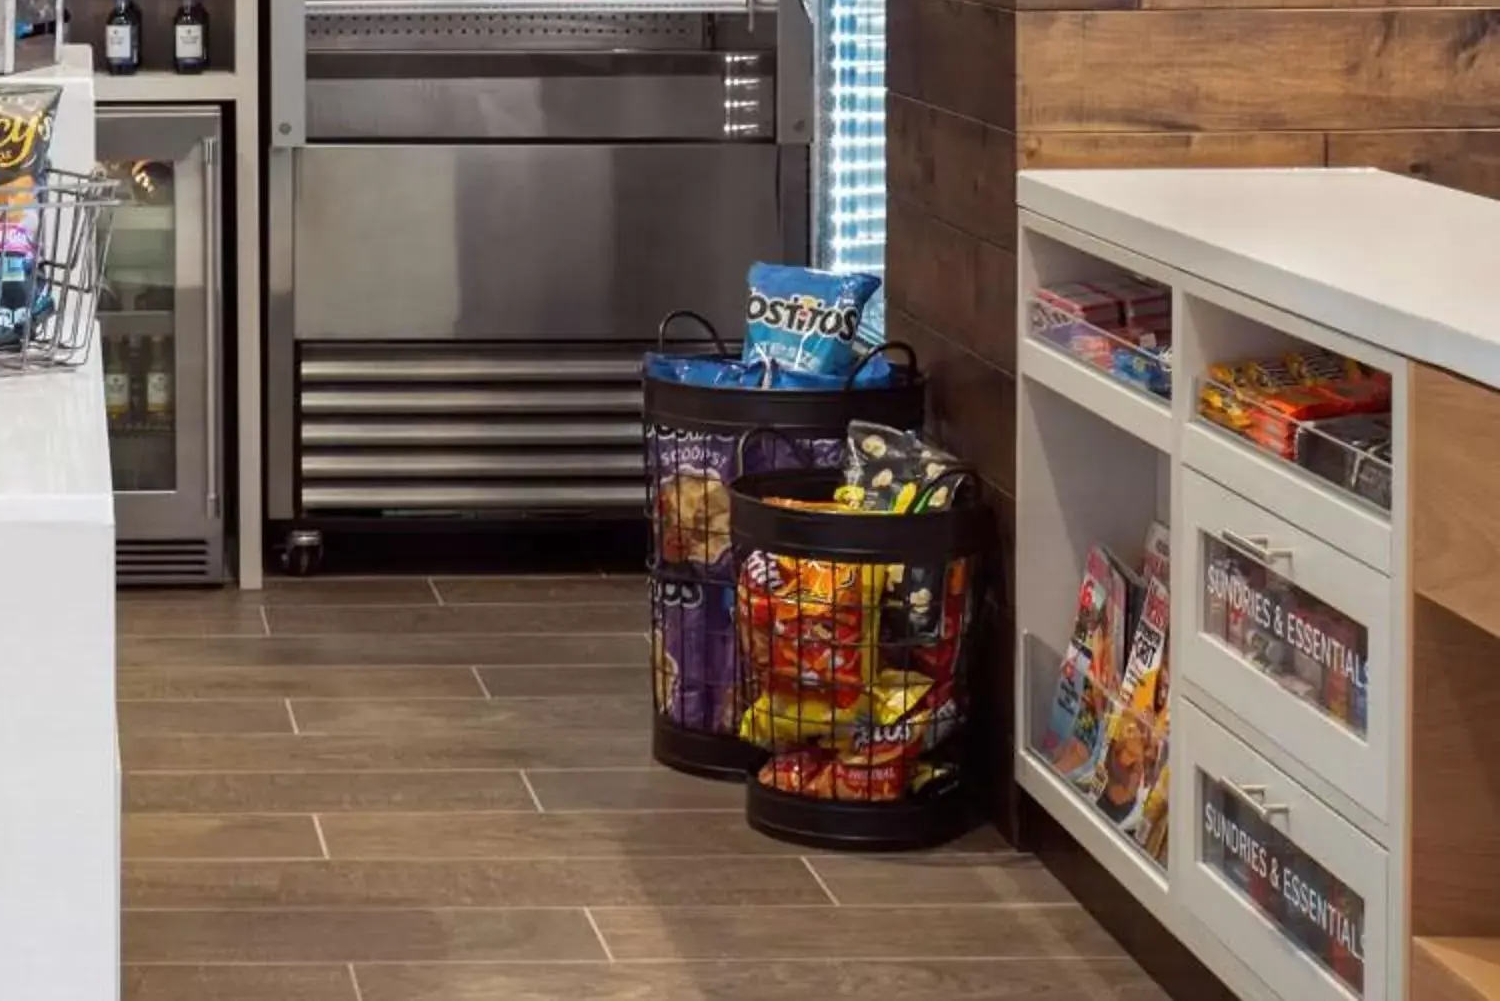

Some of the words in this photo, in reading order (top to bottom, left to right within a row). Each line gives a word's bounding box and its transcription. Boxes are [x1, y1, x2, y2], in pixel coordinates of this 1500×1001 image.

[746, 295, 860, 342] OSTITOS
[1206, 564, 1271, 629] SUNDRIES
[1273, 604, 1284, 636] &
[1204, 802, 1267, 878] SUNDRIES
[1270, 856, 1279, 889] &
